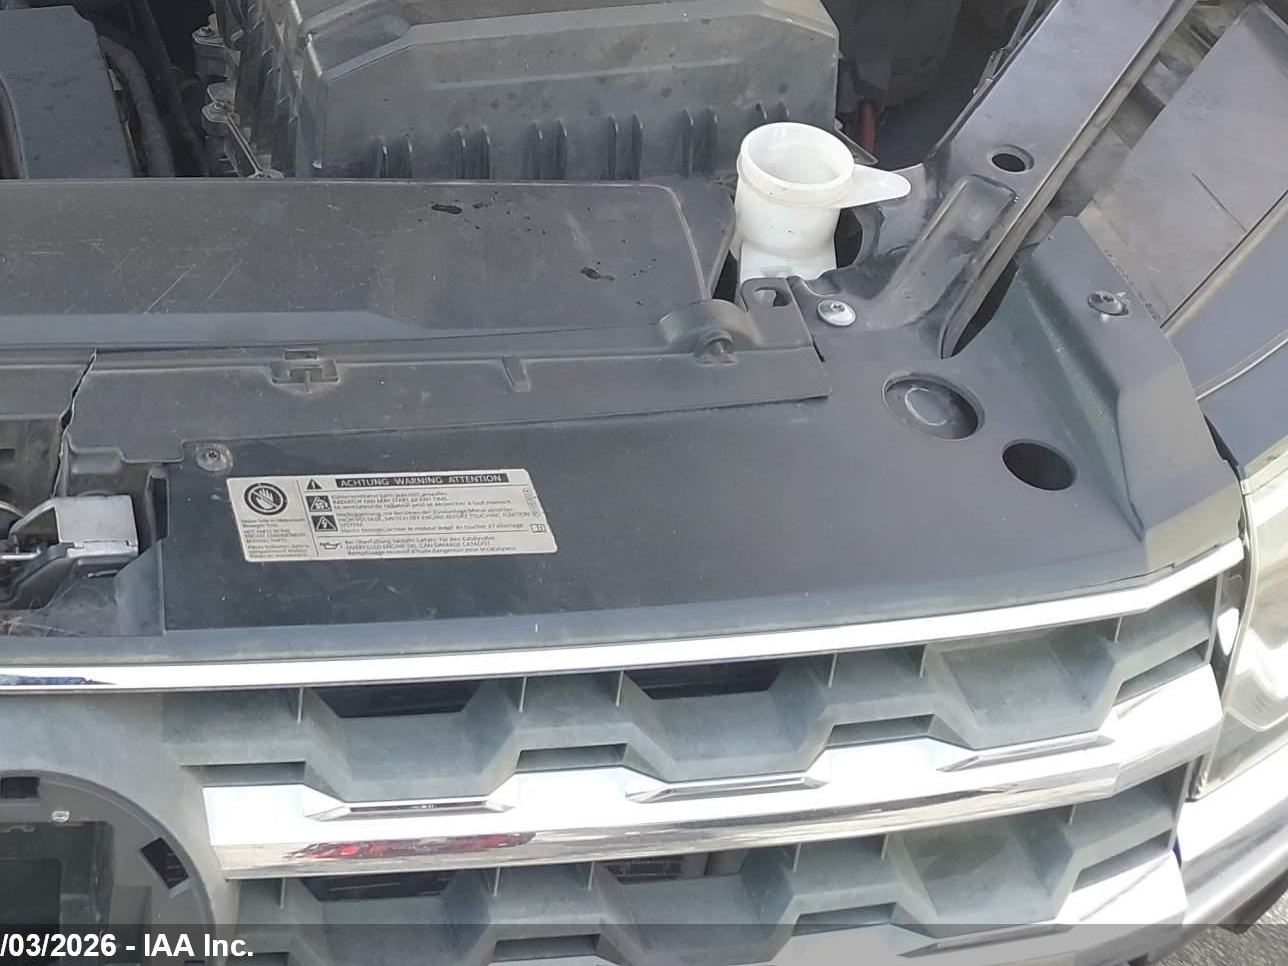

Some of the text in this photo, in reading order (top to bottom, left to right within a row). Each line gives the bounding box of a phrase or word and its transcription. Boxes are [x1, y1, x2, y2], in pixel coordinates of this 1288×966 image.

[340, 474, 502, 487] ACHTUNG WARNING ATTENTION
